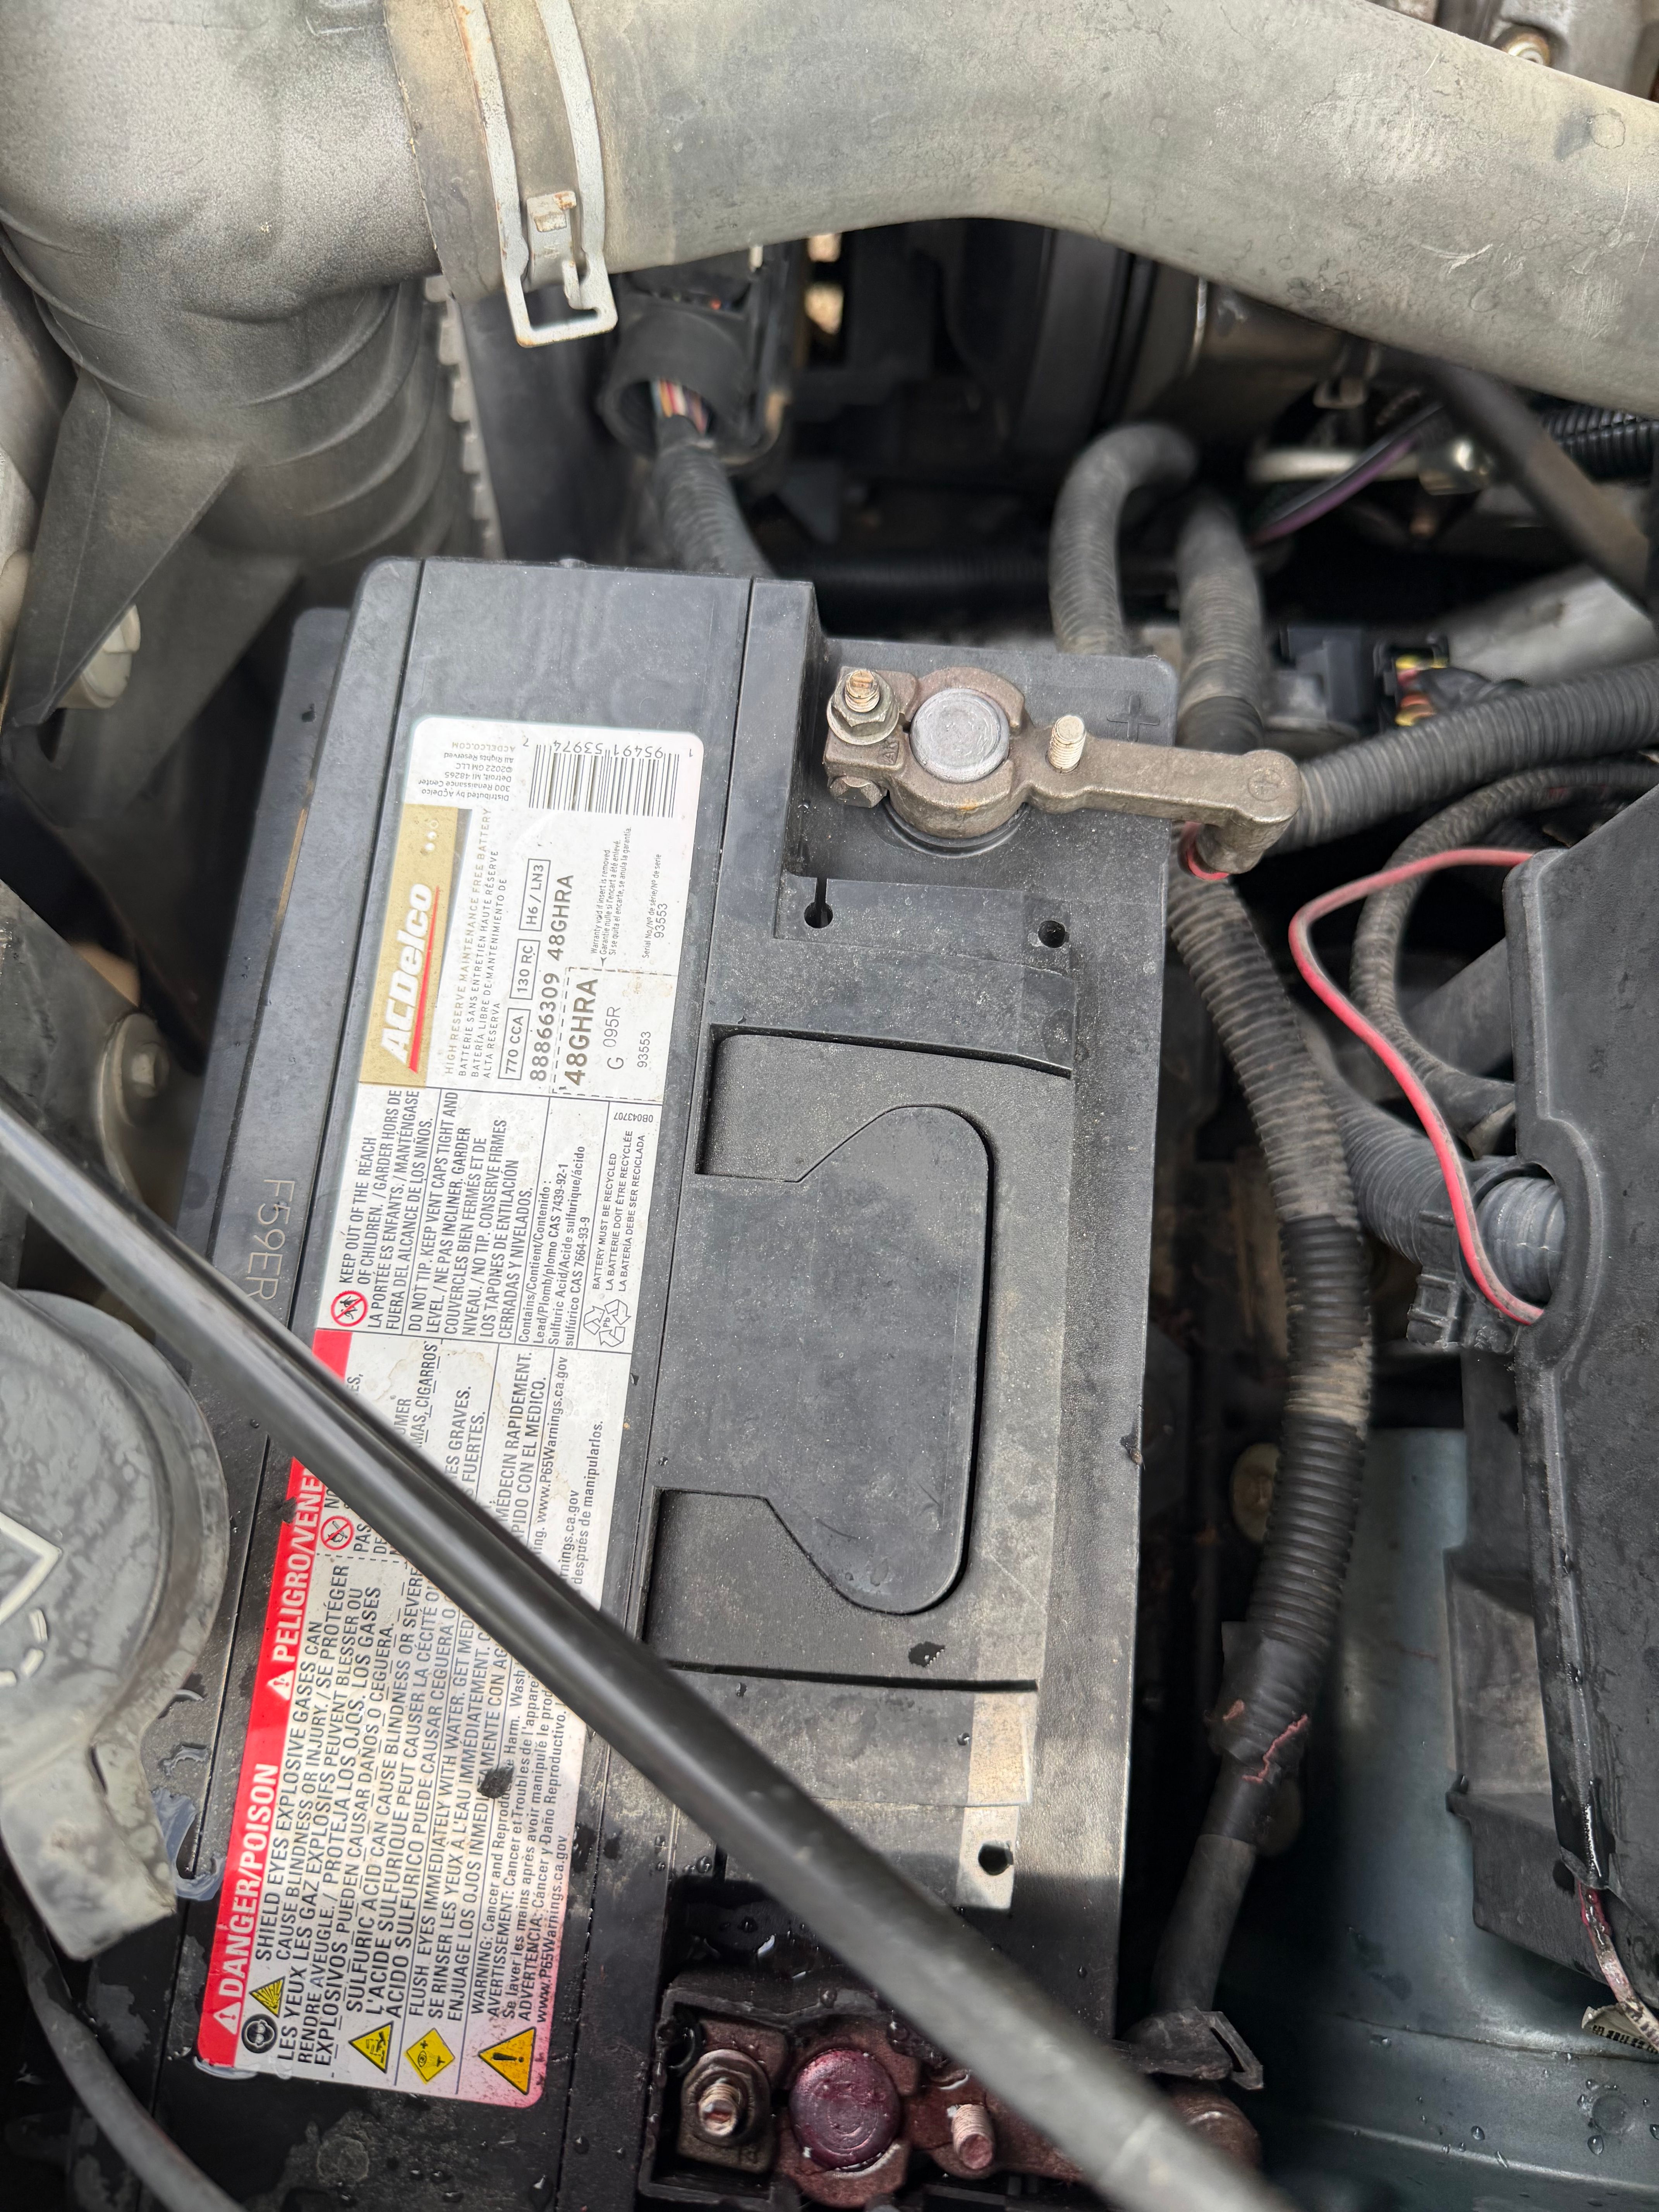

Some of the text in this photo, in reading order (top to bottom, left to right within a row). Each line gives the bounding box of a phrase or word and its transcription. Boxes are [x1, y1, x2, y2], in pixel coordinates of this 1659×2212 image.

[418, 779, 444, 787] Center
[444, 771, 470, 780] 48265
[445, 780, 493, 791] Renaissance
[452, 741, 516, 753] ACDELCO.COM
[522, 737, 694, 759] 1 95491 53974 7
[421, 788, 509, 801] Distributed by ACDelco
[526, 906, 538, 924] H6
[531, 864, 544, 890] LN3
[642, 940, 651, 958] Serial
[652, 870, 659, 878] de
[444, 808, 491, 1074] HIGH RESERVE MAINTENANCE FREE BATTERY
[590, 924, 602, 953] Warranty
[653, 903, 668, 938] 93553
[381, 884, 431, 1063] ACDelco
[517, 945, 533, 992] 130 RC
[529, 875, 574, 1081] 88866309 48GHRA
[505, 1015, 524, 1074] 770 CCA
[564, 979, 598, 1086] 48GHRA
[602, 1006, 621, 1047] 095R
[606, 1057, 624, 1069] G
[637, 1031, 651, 1067] 93553
[381, 1108, 398, 1140] HORS
[387, 1090, 402, 1105] DE
[613, 1112, 653, 1123] 0B043707
[373, 1143, 393, 1190] GARDER
[246, 1179, 295, 1300] F59ER
[339, 1137, 377, 1283] KEEP OUT OF THE REACH
[360, 1204, 383, 1266] CHILDREN.
[386, 1118, 433, 1329] FUERA DEL ALCANCE DE LOS NIÑOS.
[407, 1092, 458, 1331] DO NOT TIP. KEEP VENT CAPS TIGHT AND
[548, 1146, 585, 1345] Sulfuric Acid/Acide sulfurique/ácido
[592, 1153, 617, 1289] BATTERY MUST BE RECYCLED
[357, 1269, 372, 1285] OF
[498, 1187, 533, 1338] CERRADAS Y NIVELADOS.
[519, 1187, 550, 1342] Contains/Contient/Contenido
[533, 1164, 568, 1343] Lead/Plomb/plomo CAS 7439-92-1
[564, 1216, 590, 1346] sulfúrico CAS 7664-93-9
[603, 1317, 610, 1328] Pb
[448, 1386, 471, 1450] GRAVES.
[505, 1352, 532, 1449] RAPIDEMENT.
[517, 1377, 546, 1493] CON EL MEDICO.
[536, 1356, 568, 1523] www.P65Warnings.ca.gov
[462, 1411, 485, 1482] FUERTES.
[398, 1633, 415, 1654] OR
[384, 1660, 410, 1755] BLINDNESS
[255, 1621, 323, 1961] SHIELD EYES EXPLOSIVE GASES CAN
[275, 1565, 349, 1960] CAUSE BLINDNESS OR INJURY. / SE PROTÉGER
[375, 1759, 397, 1815] CAUSE
[276, 1588, 363, 2061] LES YEUX LES GAZ EXPLOSIFS PEUVENT BLESSER OU
[314, 1623, 394, 2066] EXPLOSIVOS PUEDEN CAUSAR DAÑOS O CEGUERA.
[370, 1821, 388, 1857] CAN
[408, 1657, 469, 2016] FLUSH EYES IMMEDIATELY WITH WATER. GET
[219, 1763, 281, 1997] DANGER/POISON
[361, 1863, 381, 1911] ACID
[346, 1916, 375, 2013] SULFURIC
[470, 1853, 503, 2014] WARNING: Cancer and
[536, 1835, 568, 2023] www.P65Warnings.ca.gov
